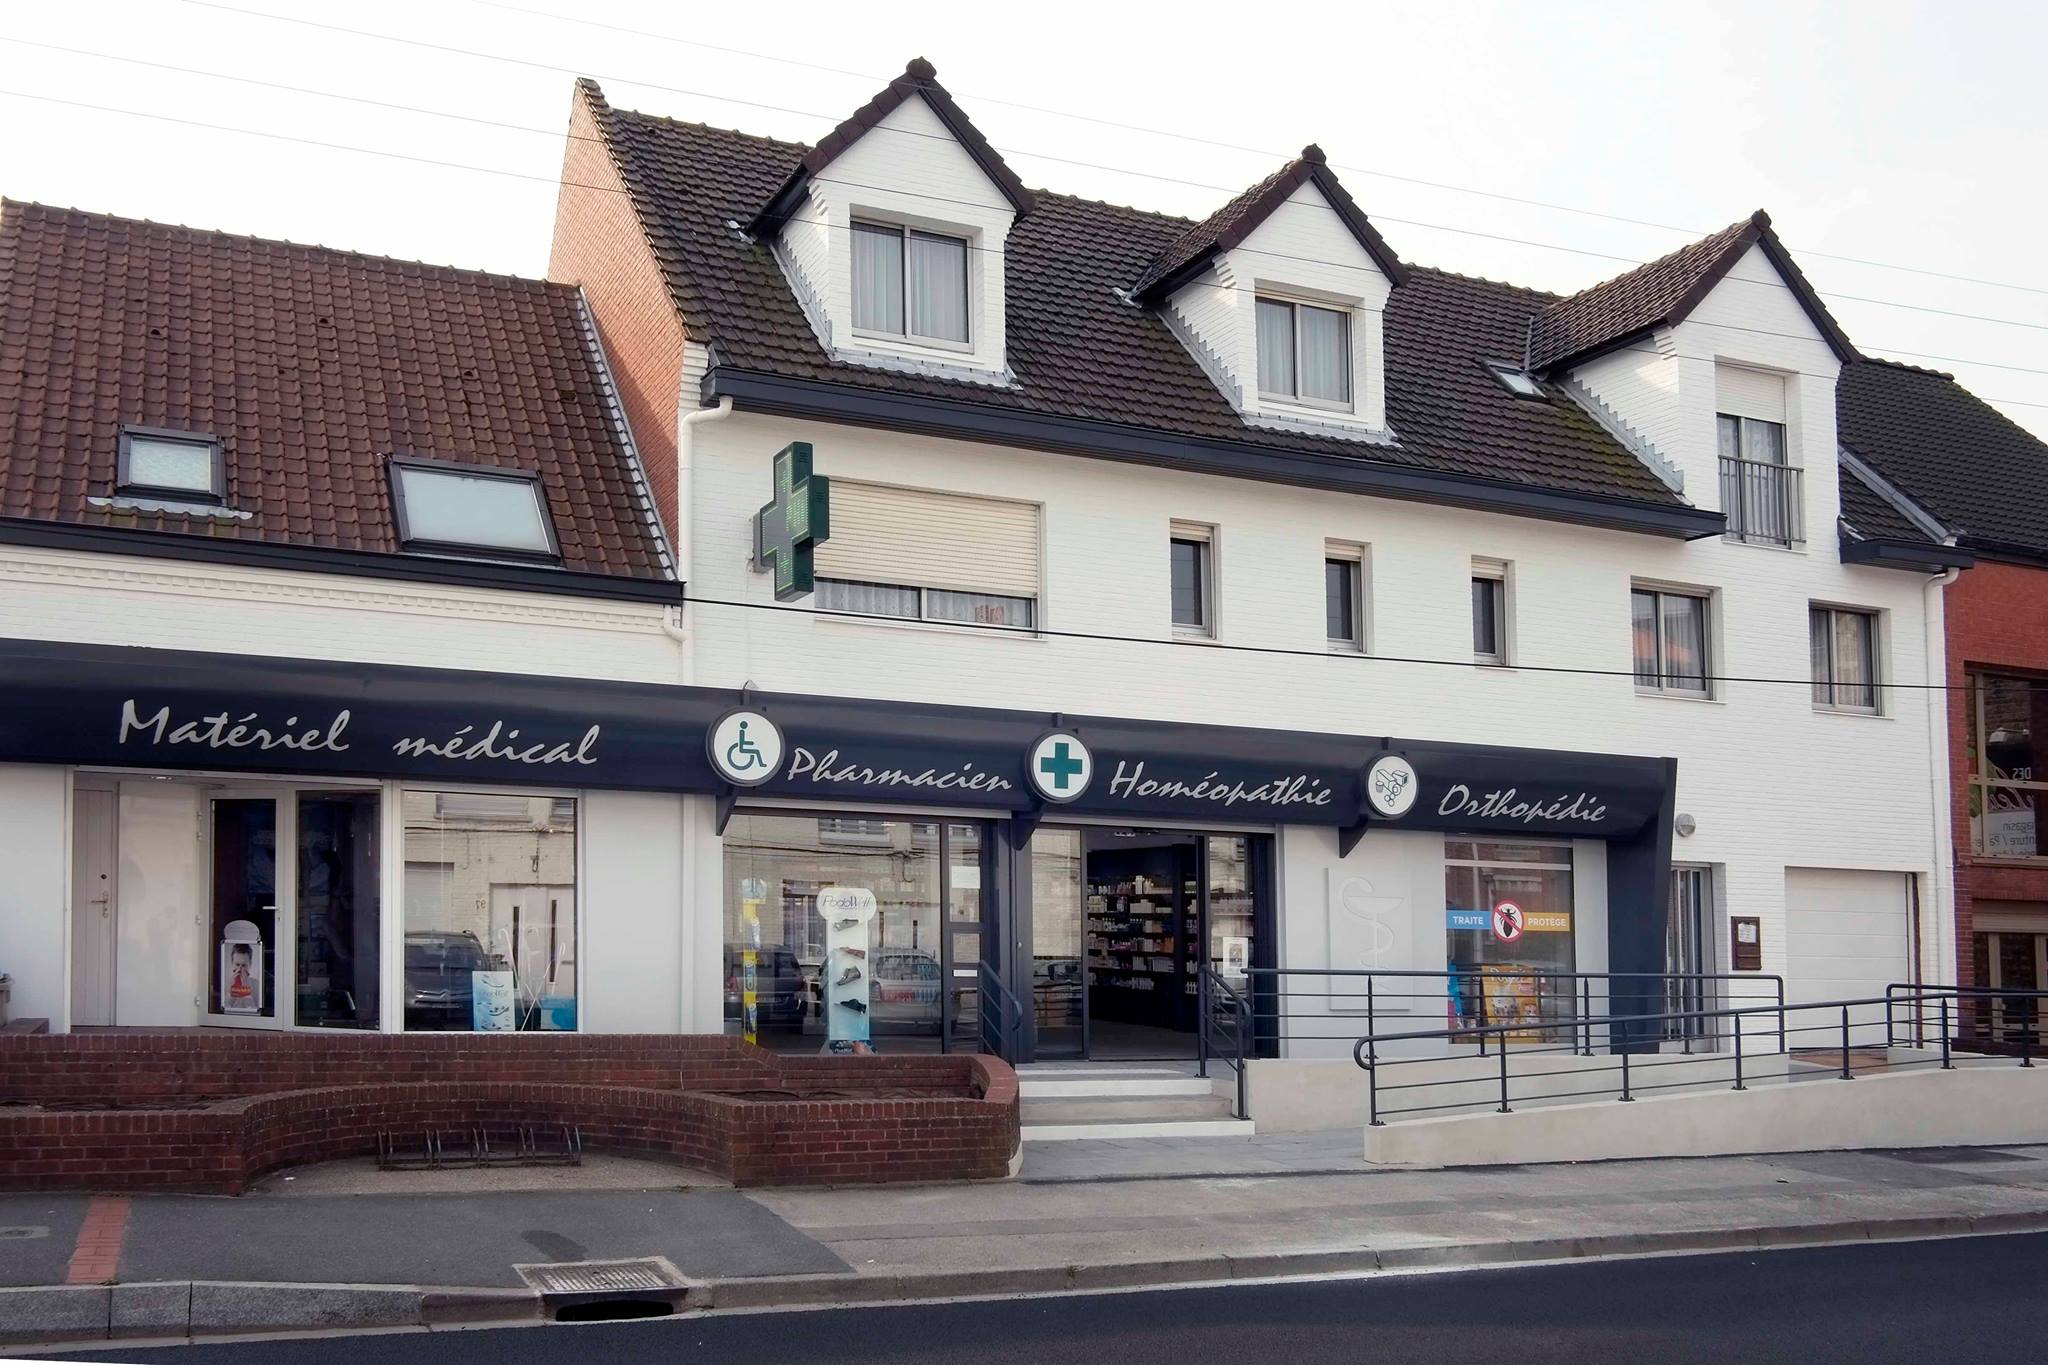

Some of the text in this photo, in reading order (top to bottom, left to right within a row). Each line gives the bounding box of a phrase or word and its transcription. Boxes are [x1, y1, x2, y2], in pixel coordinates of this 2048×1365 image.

[118, 698, 601, 765] Matériel médical
[787, 747, 1012, 792] Pharmacien
[1109, 759, 1333, 806] Homéopathie
[1437, 784, 1606, 823] Orthopédie
[1452, 915, 1485, 926] TRAITE
[1527, 916, 1567, 928] PROTÈGE
